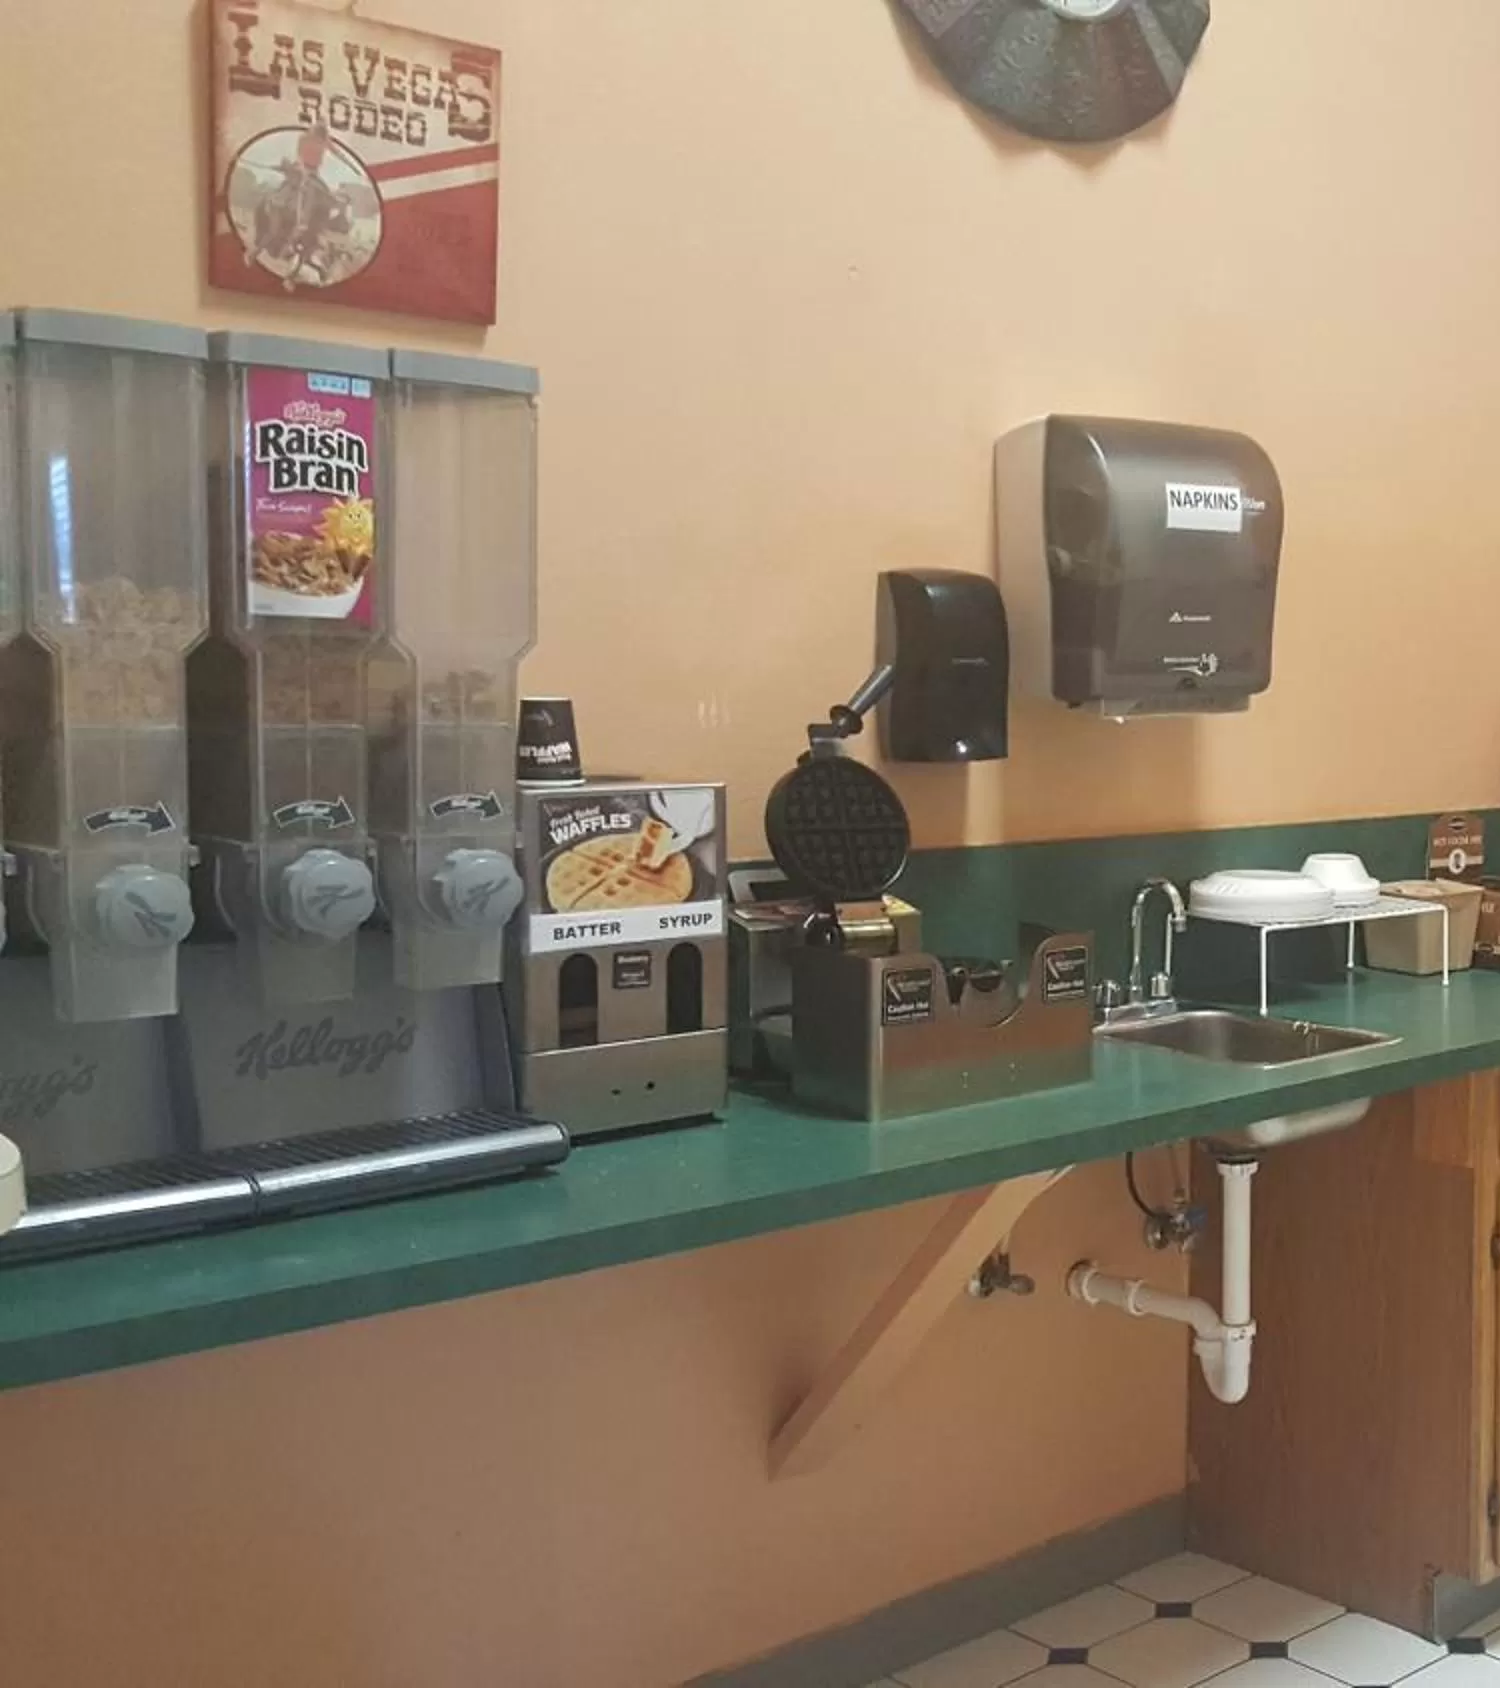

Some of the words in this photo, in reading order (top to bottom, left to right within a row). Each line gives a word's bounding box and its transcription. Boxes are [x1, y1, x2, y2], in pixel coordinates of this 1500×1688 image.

[228, 2, 324, 99] LAS
[343, 42, 492, 142] VEGAS
[298, 87, 427, 147] RODEO
[256, 420, 367, 471] Raisin
[271, 457, 357, 495] Bran
[1169, 489, 1239, 511] NAPKINS
[549, 813, 631, 845] WAFFLES
[553, 922, 622, 941] BATTER
[659, 912, 713, 930] SYRUP
[234, 1016, 417, 1080] Kellogg's
